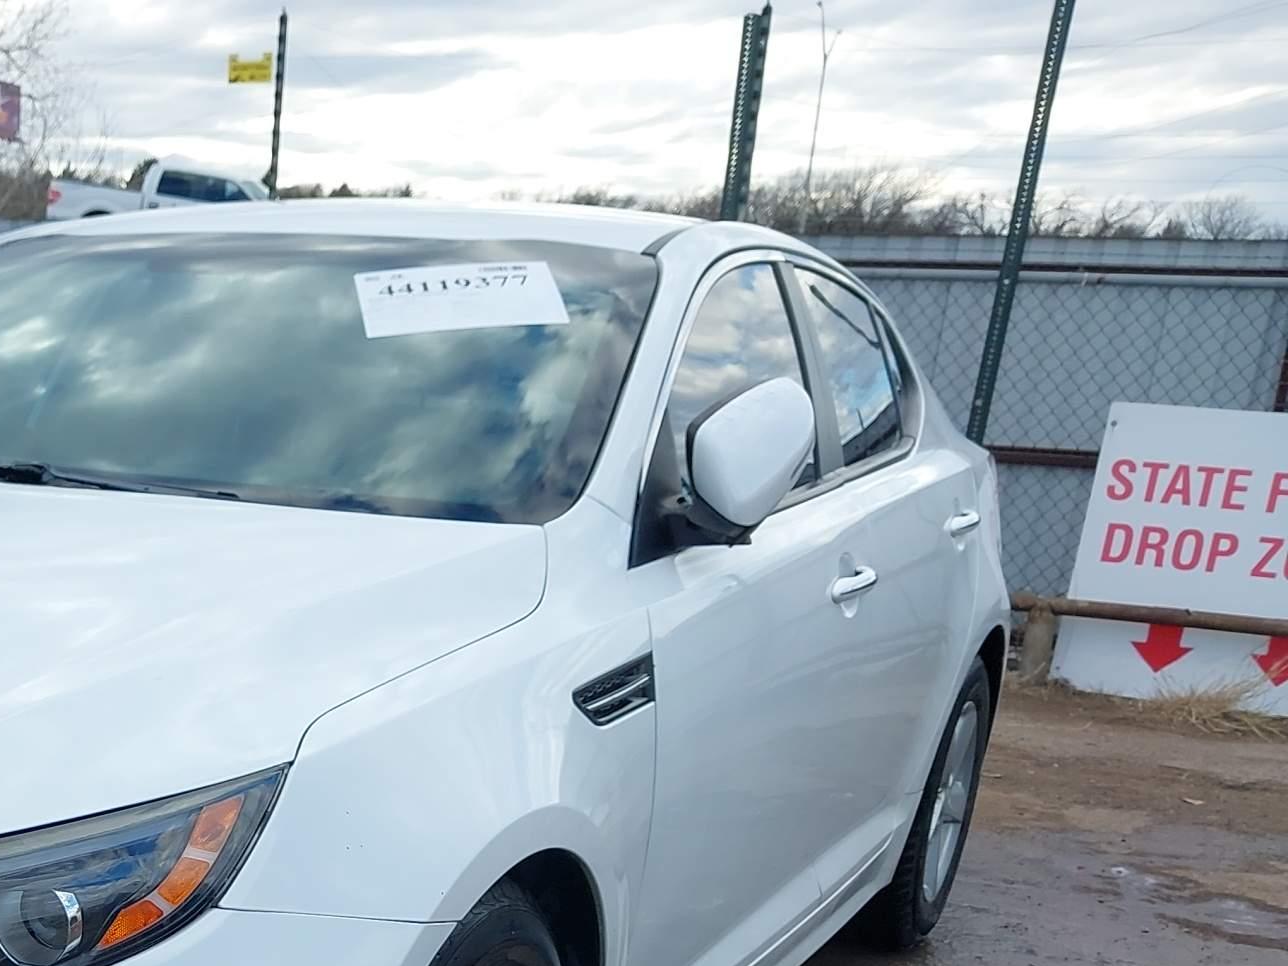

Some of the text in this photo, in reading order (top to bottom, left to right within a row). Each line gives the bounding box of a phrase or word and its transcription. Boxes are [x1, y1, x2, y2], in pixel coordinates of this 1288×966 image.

[378, 274, 528, 297] 44119377
[1106, 458, 1253, 510] STATE
[1100, 522, 1288, 581] DROP Z
